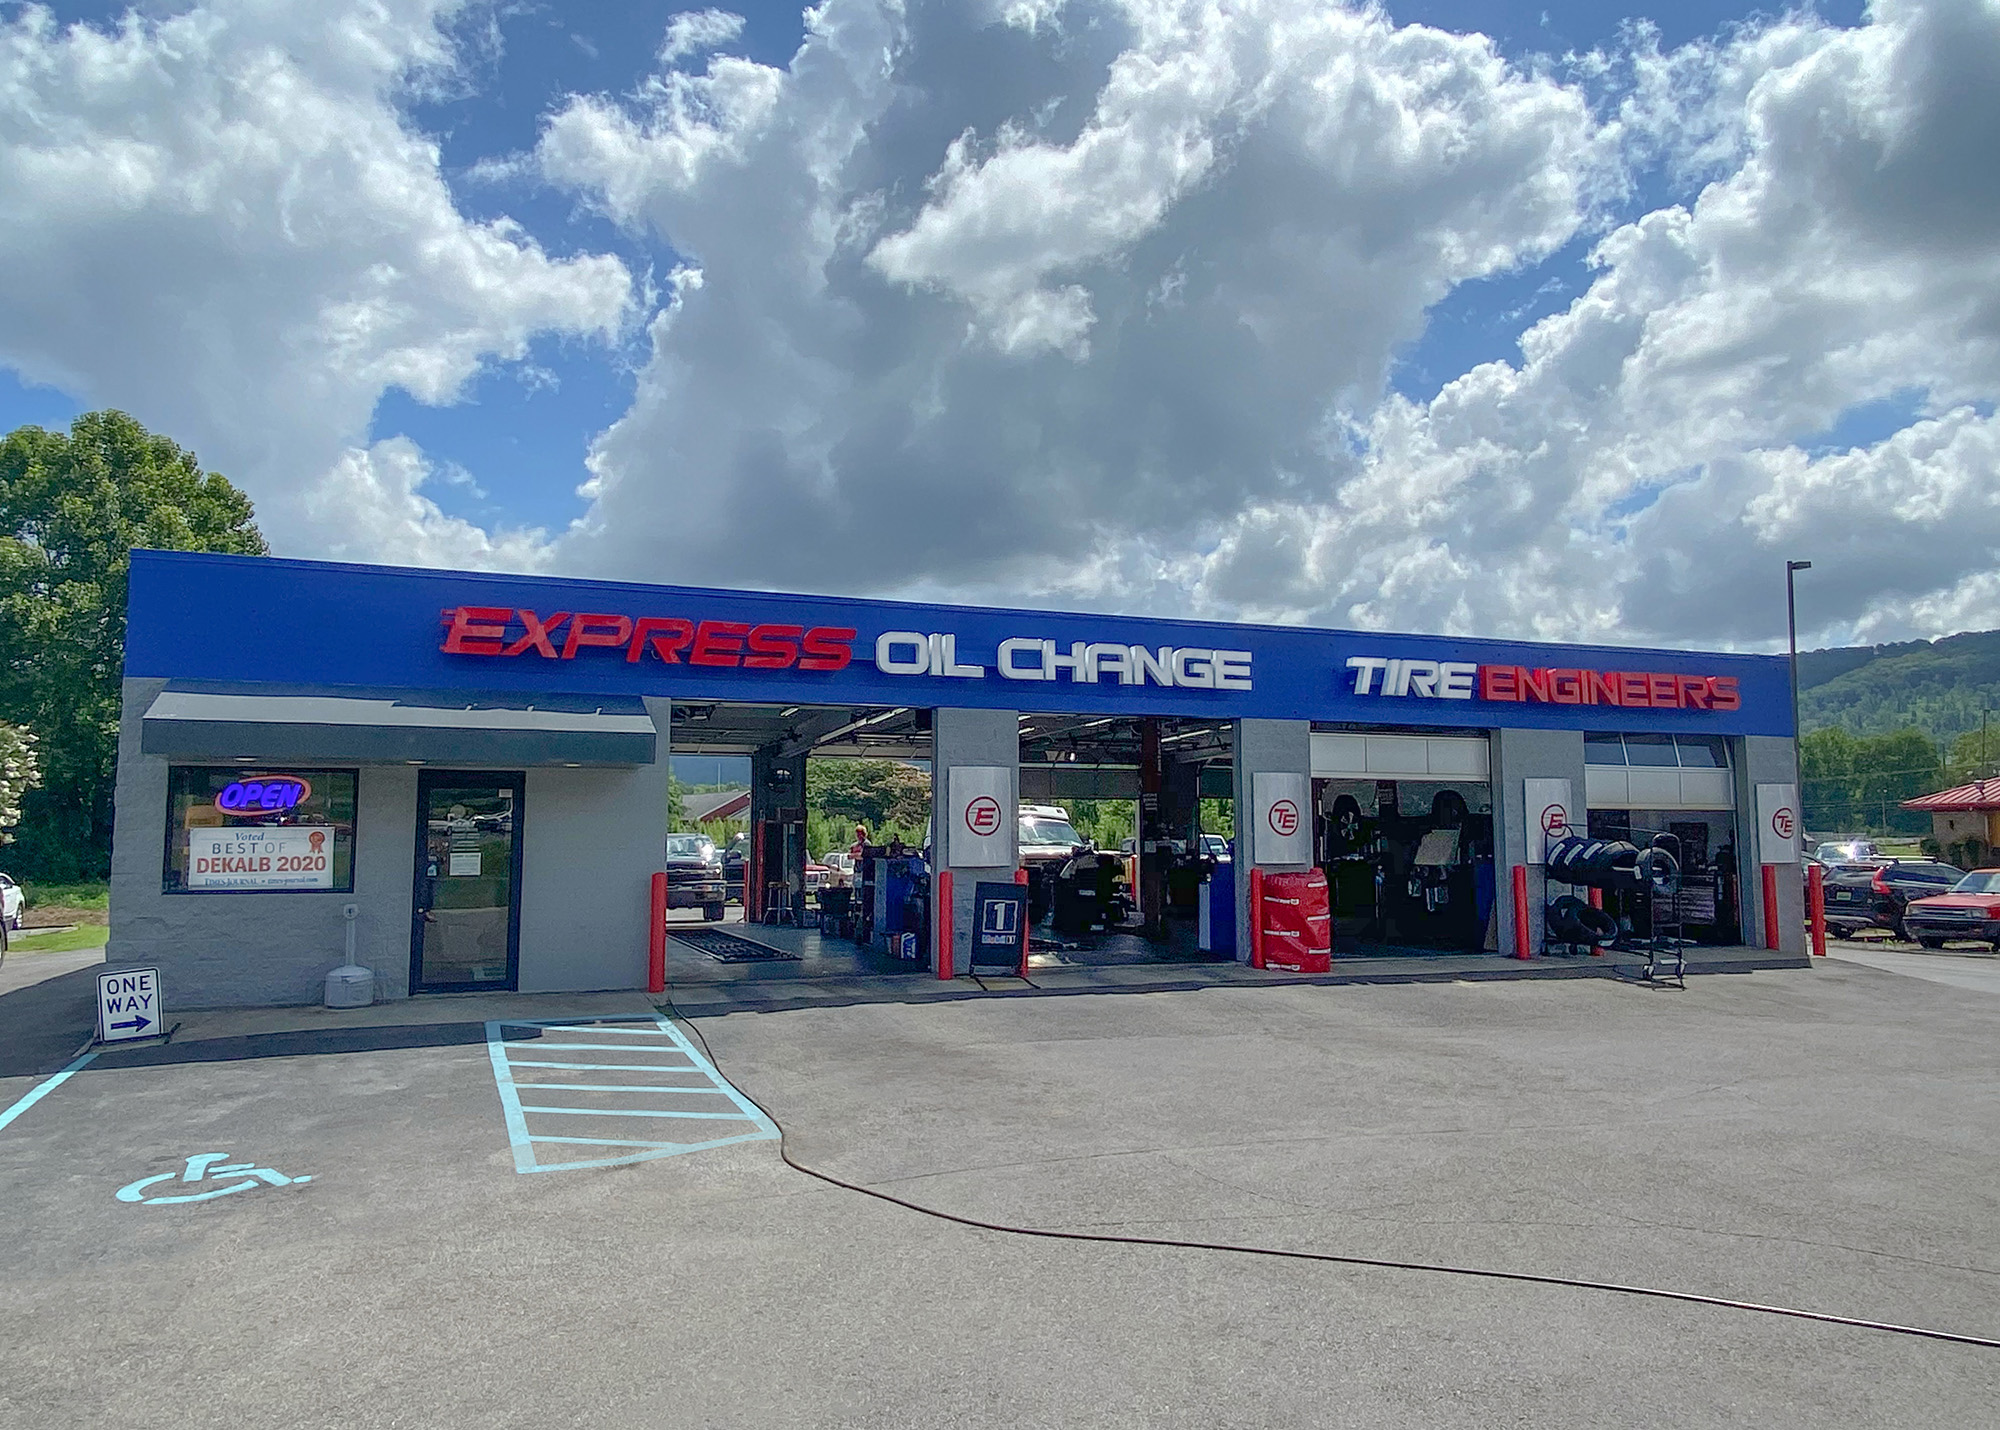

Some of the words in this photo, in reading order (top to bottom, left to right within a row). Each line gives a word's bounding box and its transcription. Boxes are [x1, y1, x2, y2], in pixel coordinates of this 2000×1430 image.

[440, 606, 857, 671] EXPRESS
[876, 630, 985, 678] OIL
[997, 636, 1253, 691] CHANGE
[1346, 656, 1478, 700] TIRE
[1478, 665, 1742, 711] ENGINEERS
[220, 783, 302, 809] OPEN
[1274, 808, 1296, 829] TE
[235, 832, 265, 841] Voted
[212, 842, 258, 855] BEST
[264, 842, 287, 854] OF
[196, 857, 272, 874] DEKALB
[276, 855, 327, 872] 2020
[994, 902, 1006, 930] 1
[106, 975, 152, 995] ONE
[106, 993, 153, 1014] WAY
